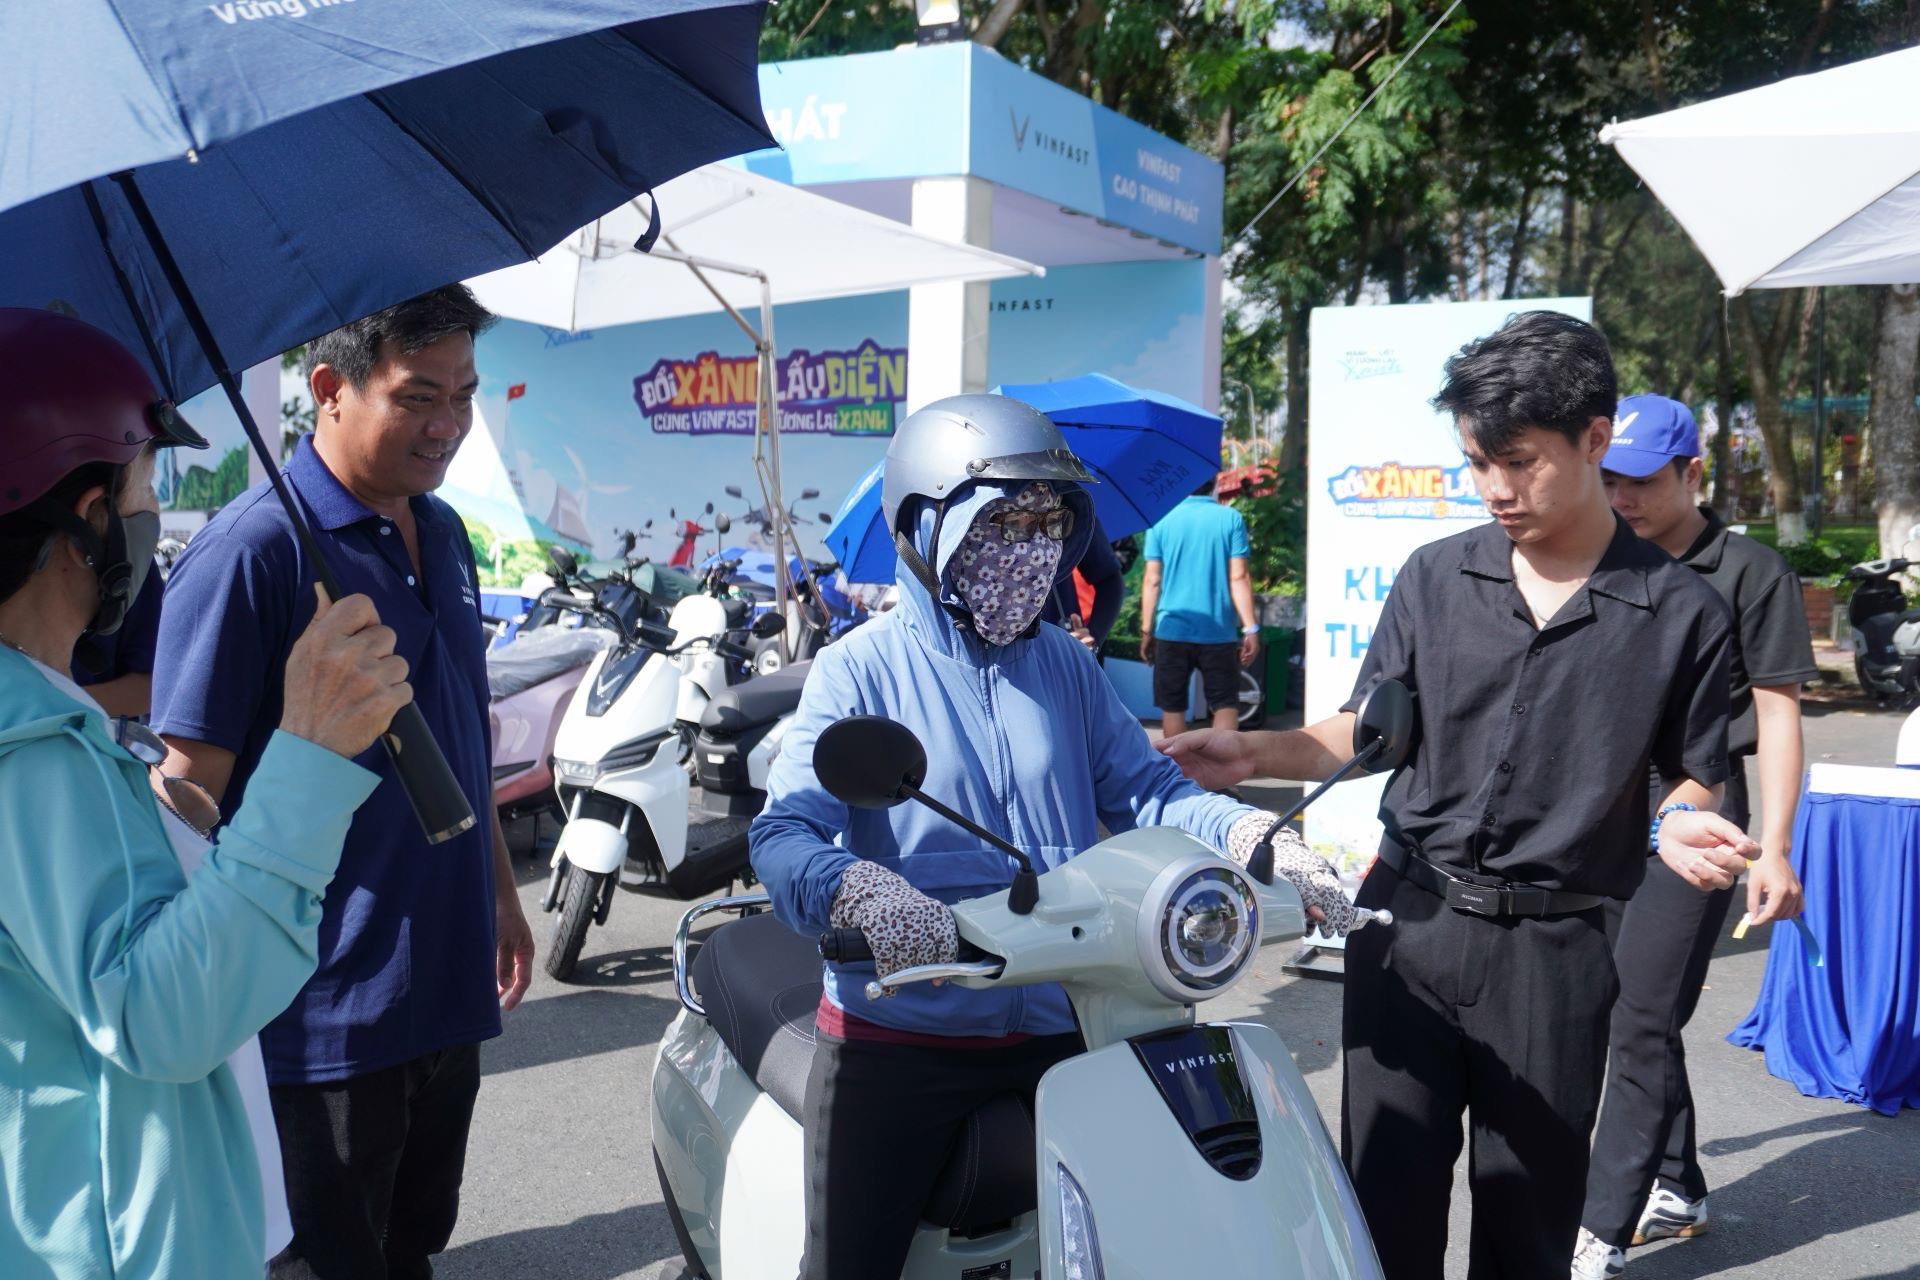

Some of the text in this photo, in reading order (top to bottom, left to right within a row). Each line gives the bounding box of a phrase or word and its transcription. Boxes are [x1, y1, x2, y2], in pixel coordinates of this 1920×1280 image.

[764, 94, 848, 143] HÁT
[1034, 130, 1089, 165] VINFAST
[1137, 148, 1182, 184] VINFAST
[1113, 174, 1137, 200] CAO
[989, 299, 1054, 311] INFAST
[1360, 463, 1444, 499] XĂNG
[1344, 566, 1397, 601] KH
[1325, 623, 1374, 659] TH
[1165, 1052, 1234, 1073] VINFAST
